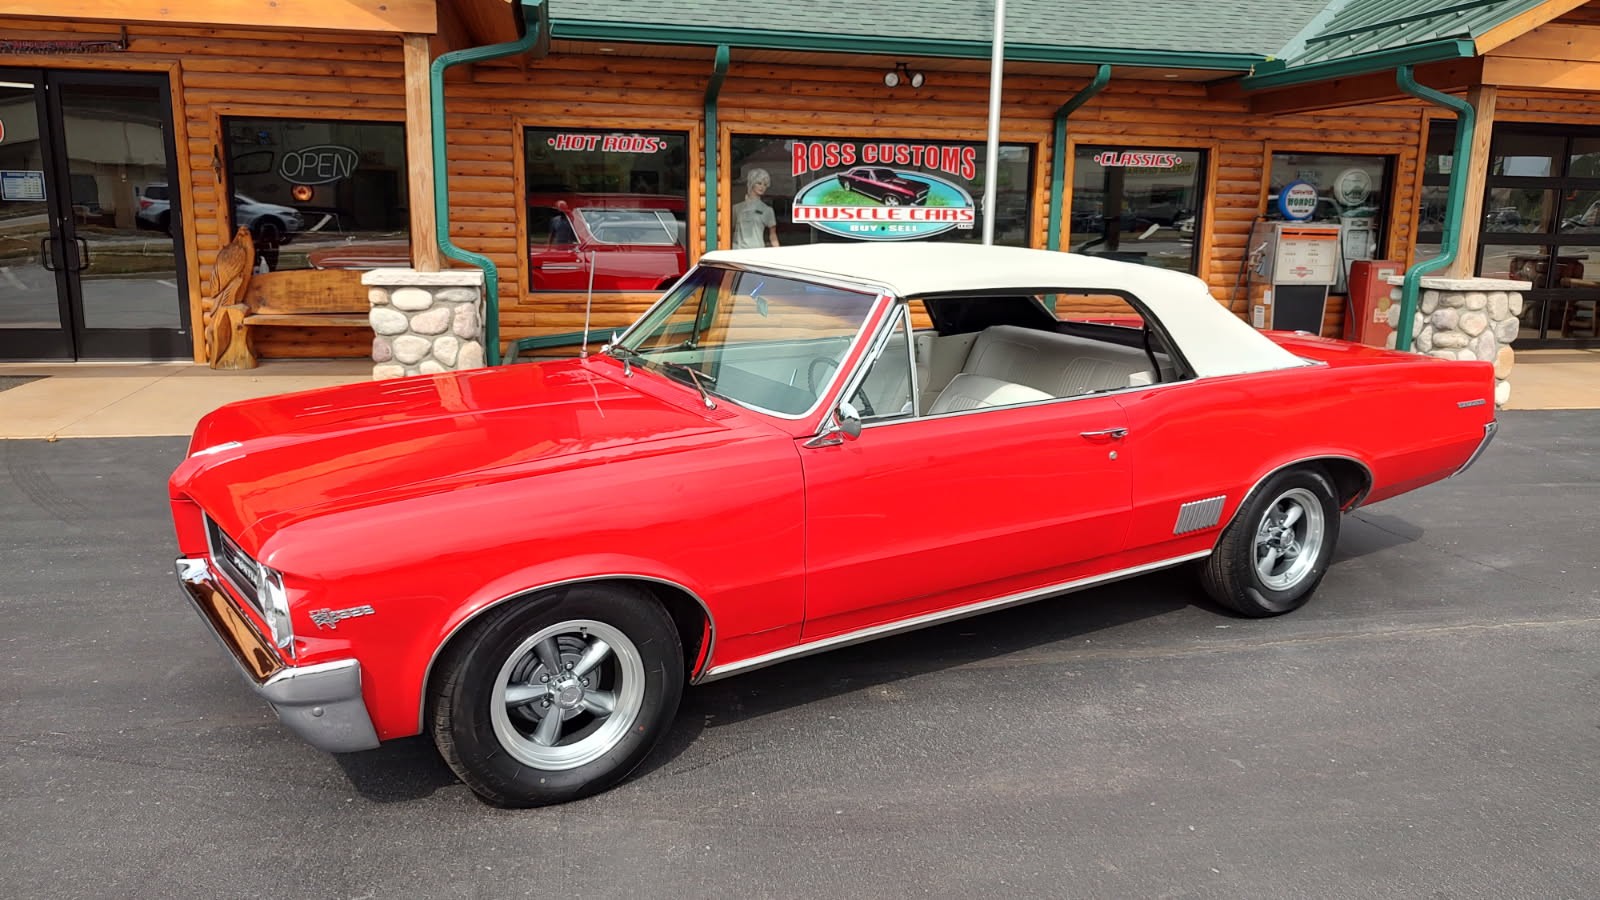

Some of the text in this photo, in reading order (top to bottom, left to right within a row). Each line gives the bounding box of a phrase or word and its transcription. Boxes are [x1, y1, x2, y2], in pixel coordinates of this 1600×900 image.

[555, 134, 660, 153] HOT RODS
[282, 152, 352, 177] OPEN
[791, 142, 976, 180] ROSS CUSTOMS
[1100, 151, 1177, 168] CLASSICS
[793, 207, 974, 221] MUSCLE CARS
